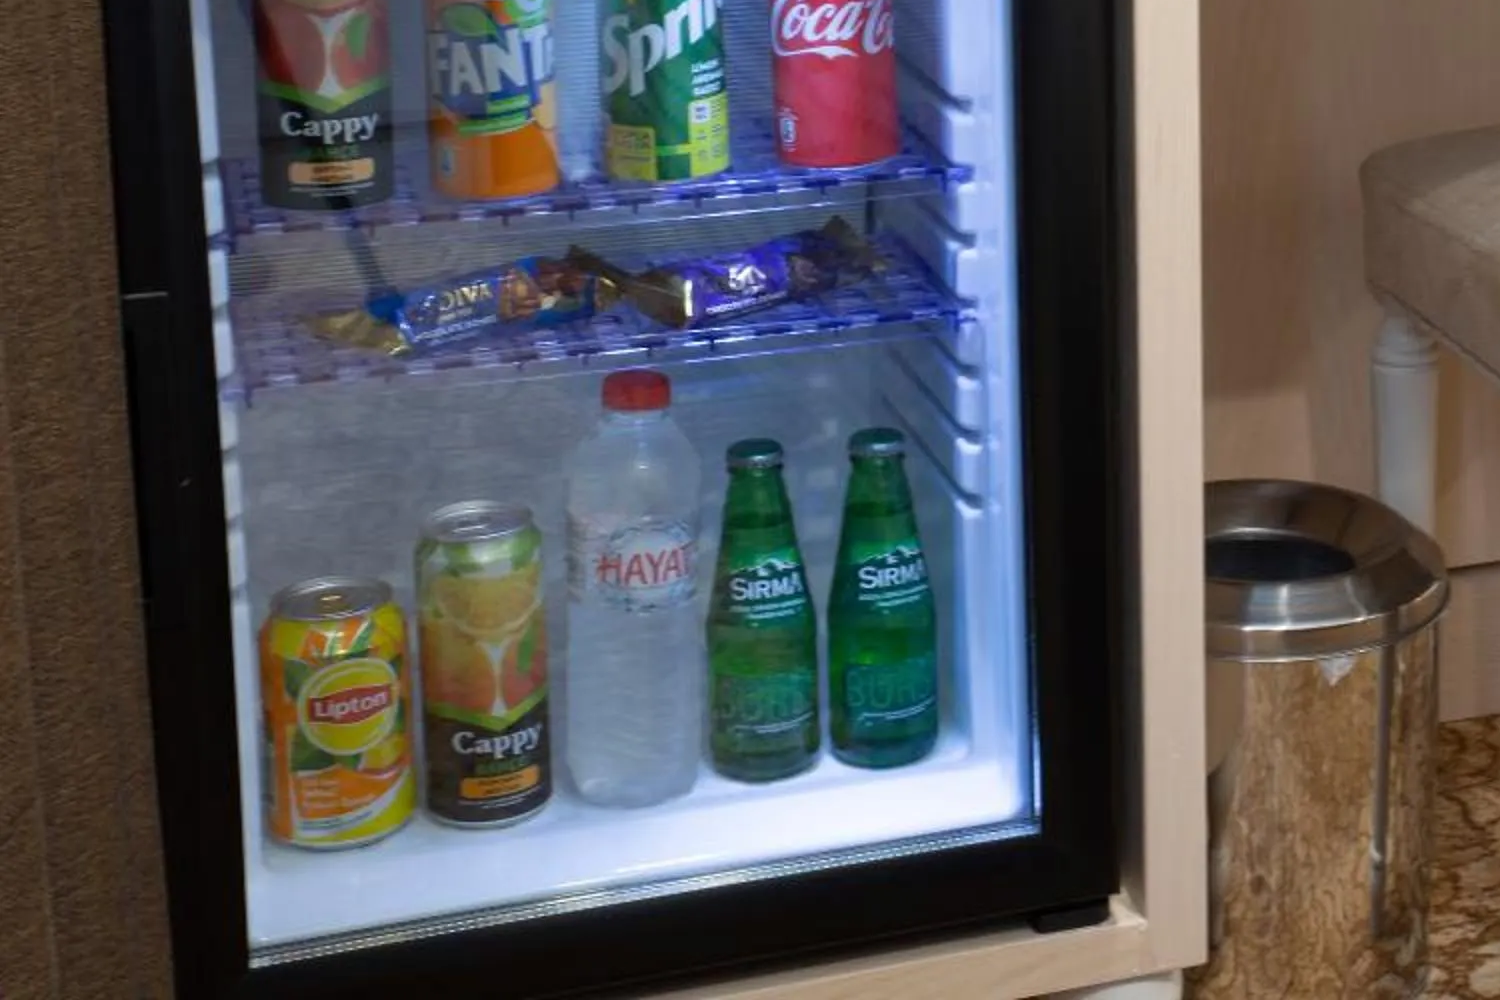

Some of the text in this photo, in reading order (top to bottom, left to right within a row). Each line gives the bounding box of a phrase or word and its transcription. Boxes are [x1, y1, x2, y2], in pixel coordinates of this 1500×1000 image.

[428, 22, 554, 96] FANT
[280, 111, 379, 145] Cappy
[313, 690, 388, 721] Lipton
[452, 721, 543, 760] Cappy
